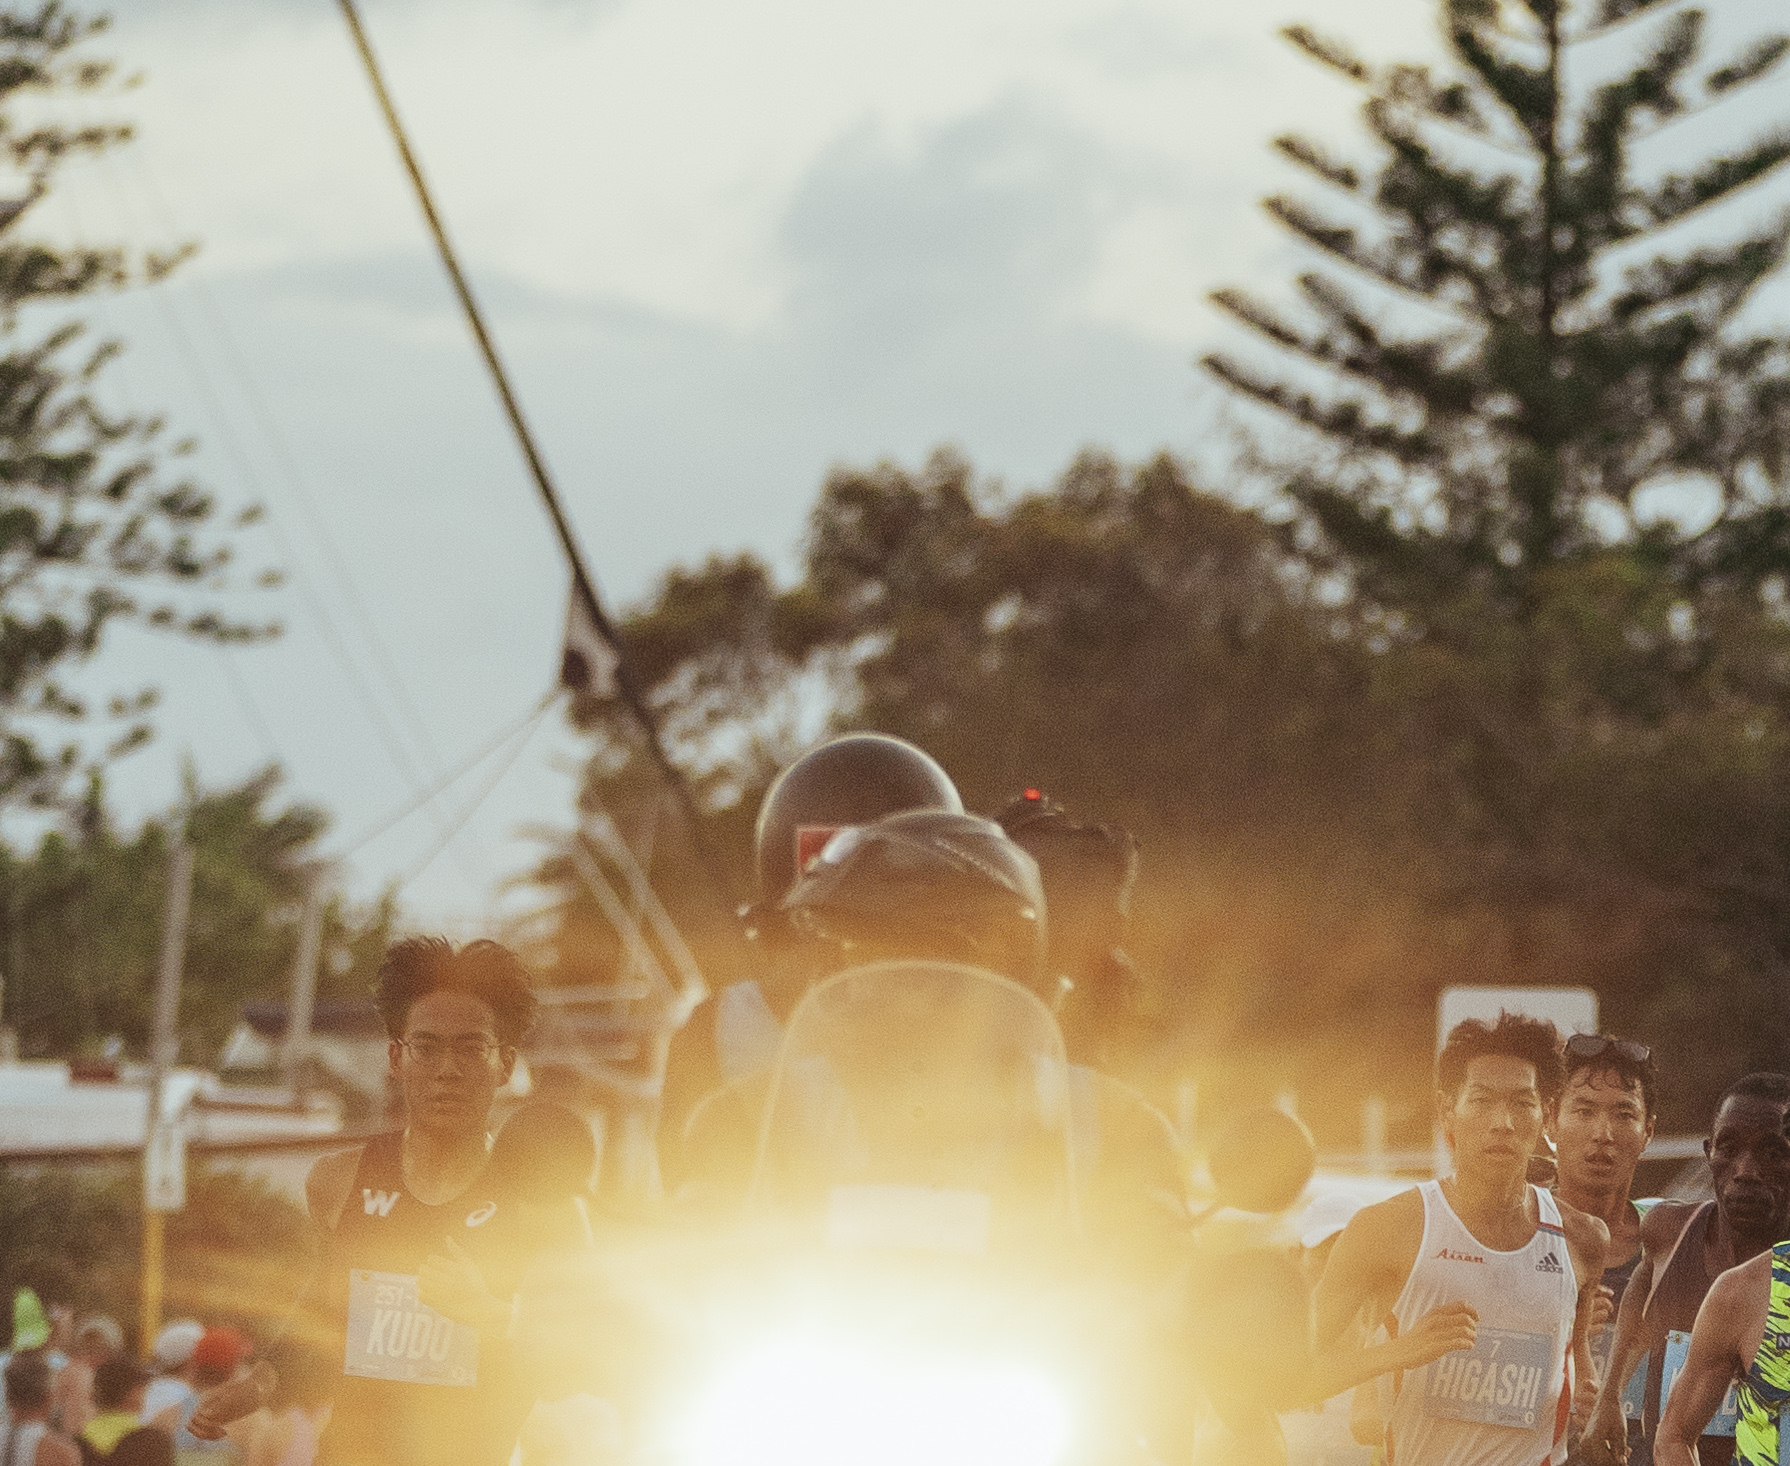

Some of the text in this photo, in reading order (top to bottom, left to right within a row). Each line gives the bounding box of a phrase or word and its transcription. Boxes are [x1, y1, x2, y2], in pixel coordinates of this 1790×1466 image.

[1535, 1263, 1564, 1275] adidas
[366, 1308, 455, 1362] KUDO
[1489, 1340, 1502, 1358] 7
[1430, 1356, 1543, 1410] HIGASHI
